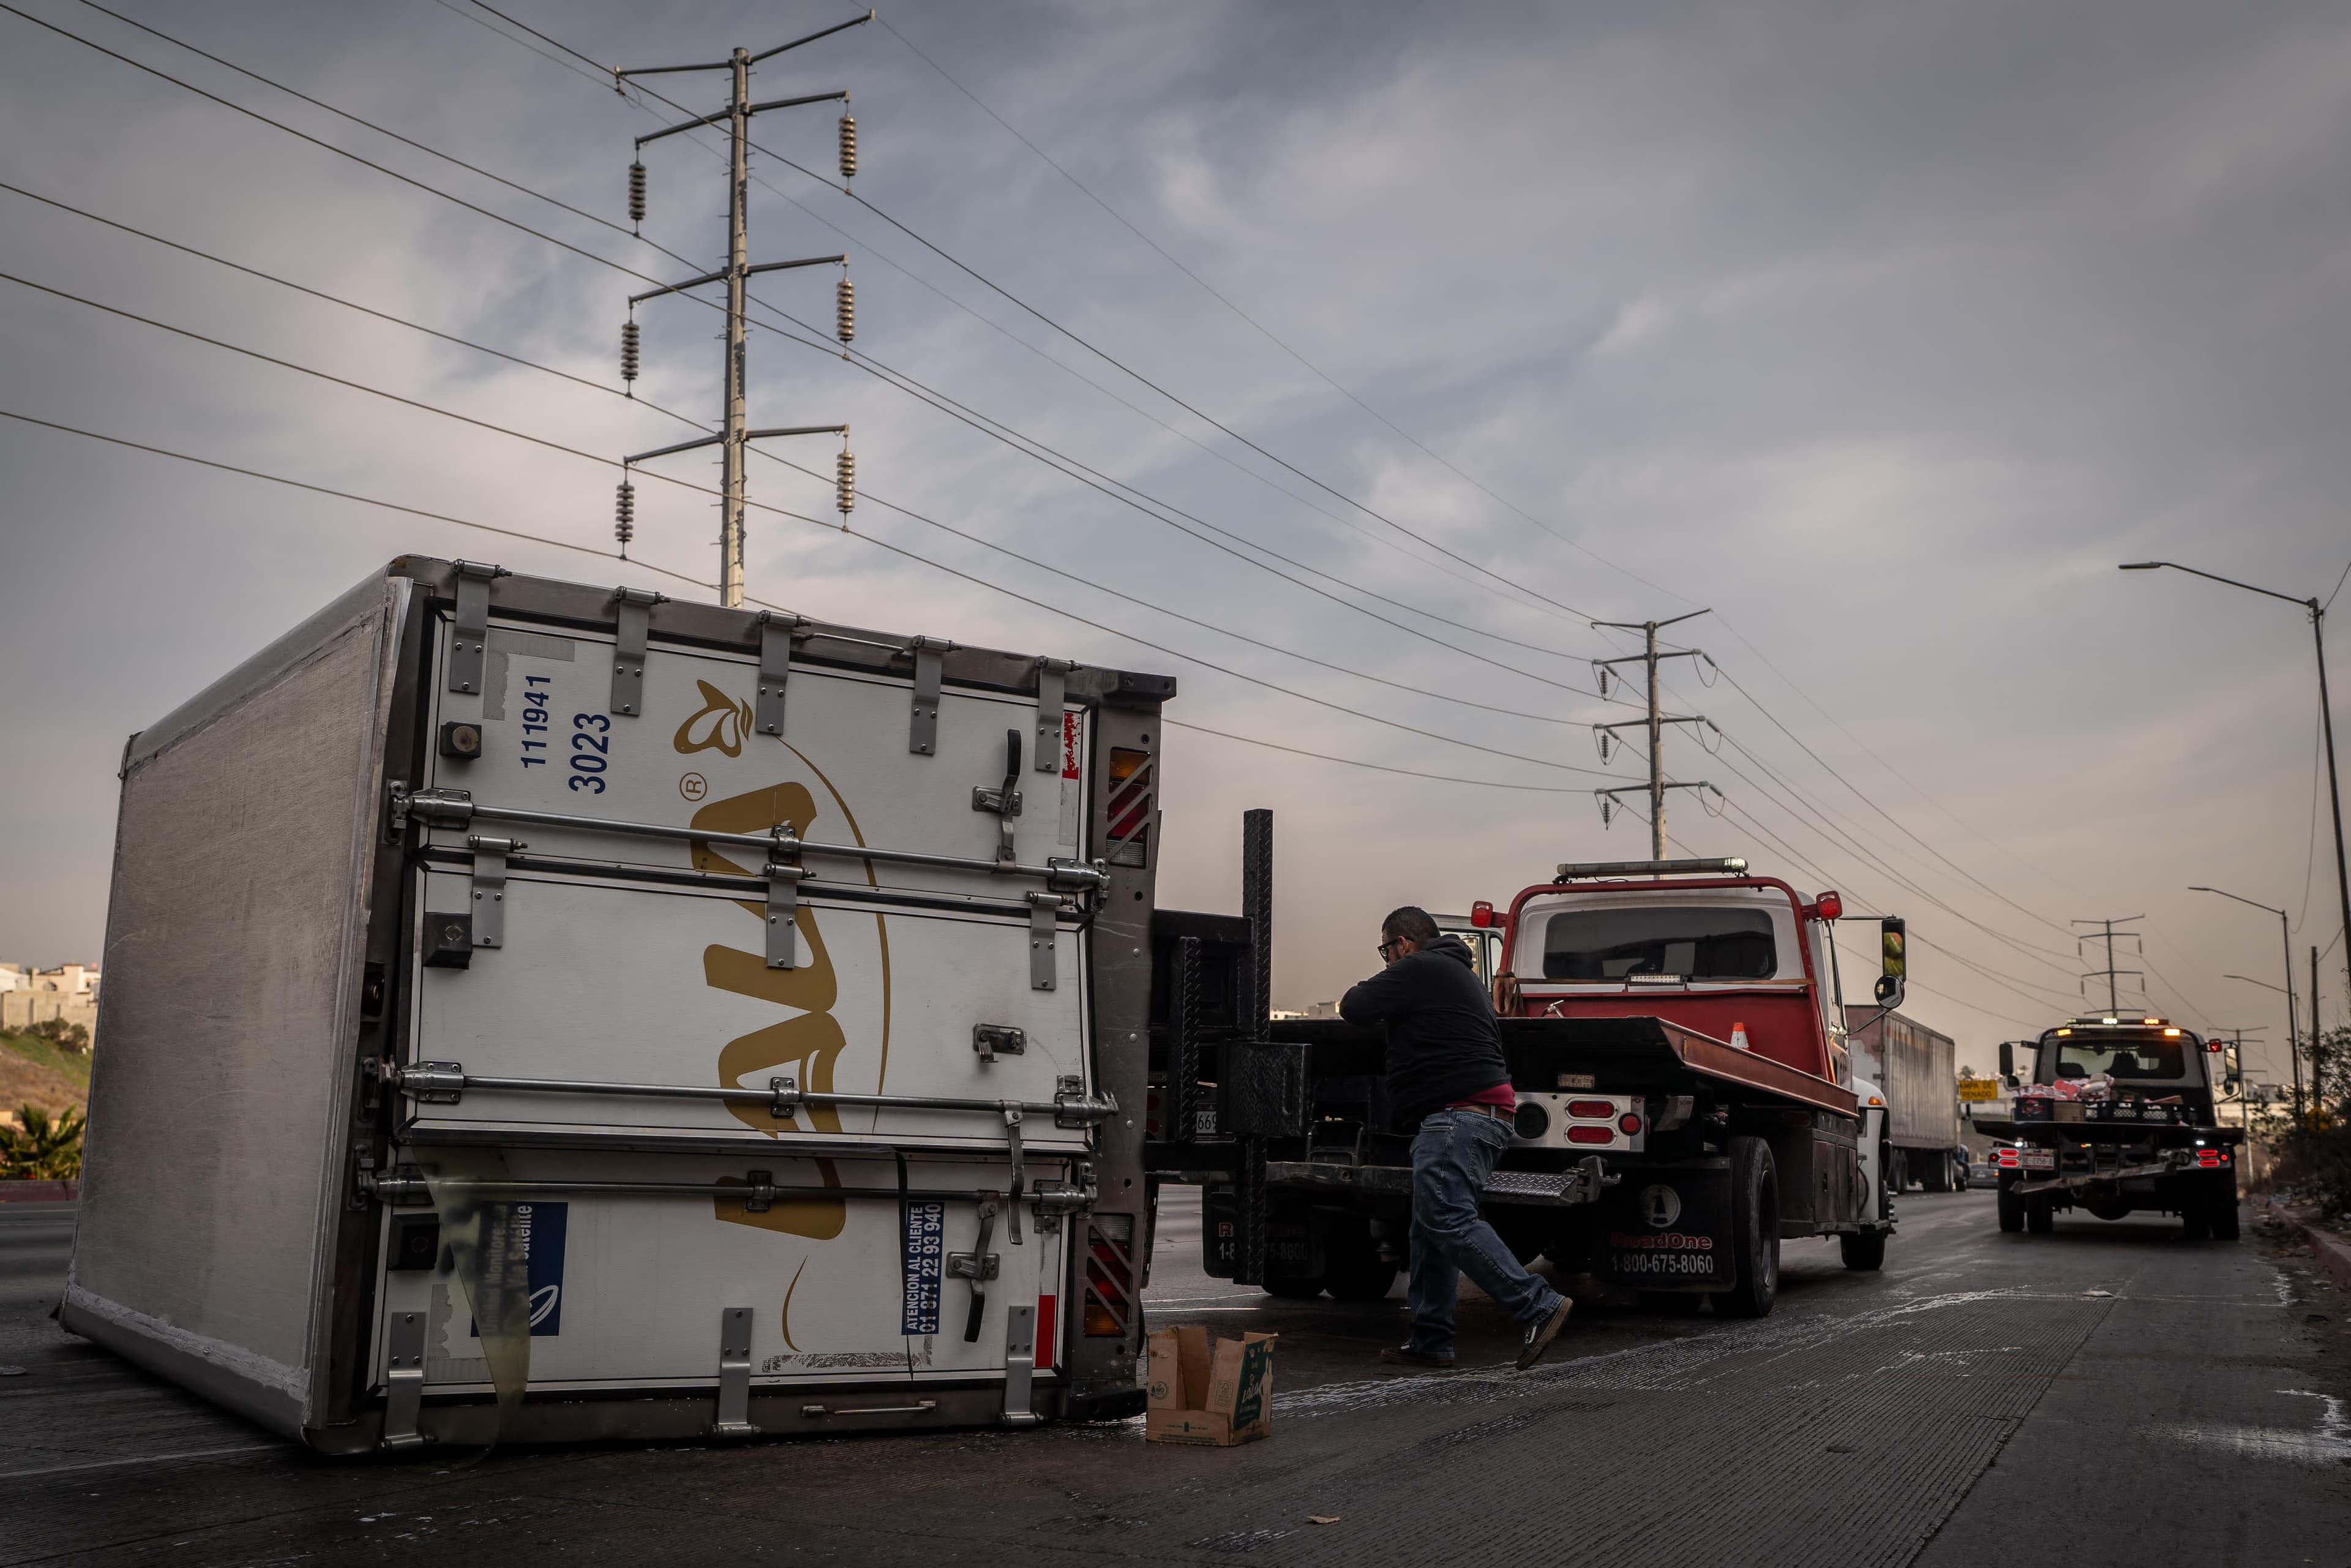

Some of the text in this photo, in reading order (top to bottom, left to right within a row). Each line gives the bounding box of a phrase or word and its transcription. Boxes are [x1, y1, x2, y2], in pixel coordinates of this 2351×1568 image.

[520, 675, 551, 769] 111941
[568, 713, 610, 795] 3023
[907, 1207, 923, 1330] ATENCION AL CLIENTE
[919, 1204, 942, 1333] 01 871 22 93 940
[1610, 1230, 1713, 1250] RoadOne
[1611, 1251, 1714, 1274] 1-800-675-8060
